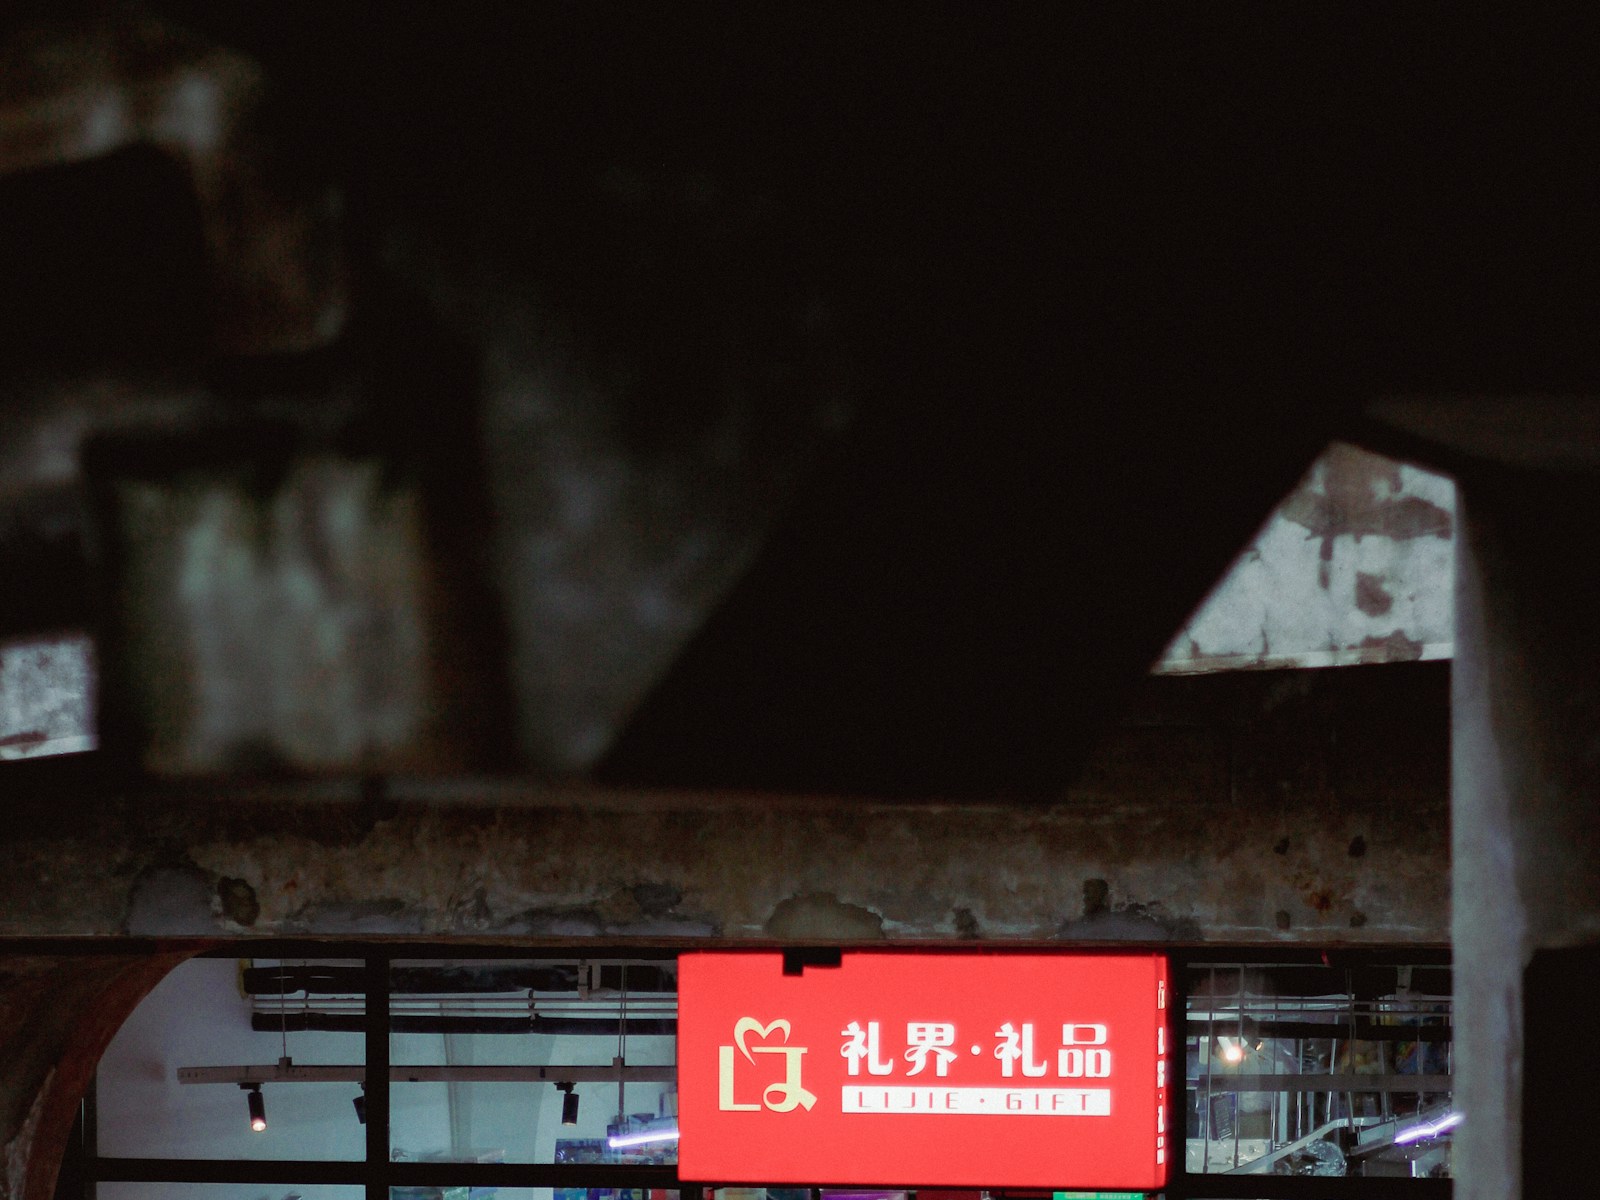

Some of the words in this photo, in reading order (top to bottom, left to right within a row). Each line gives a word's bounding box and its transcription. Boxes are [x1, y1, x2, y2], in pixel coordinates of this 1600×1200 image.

[840, 1021, 1111, 1078] 礼界·礼品
[1006, 1092, 1090, 1112] GIFT
